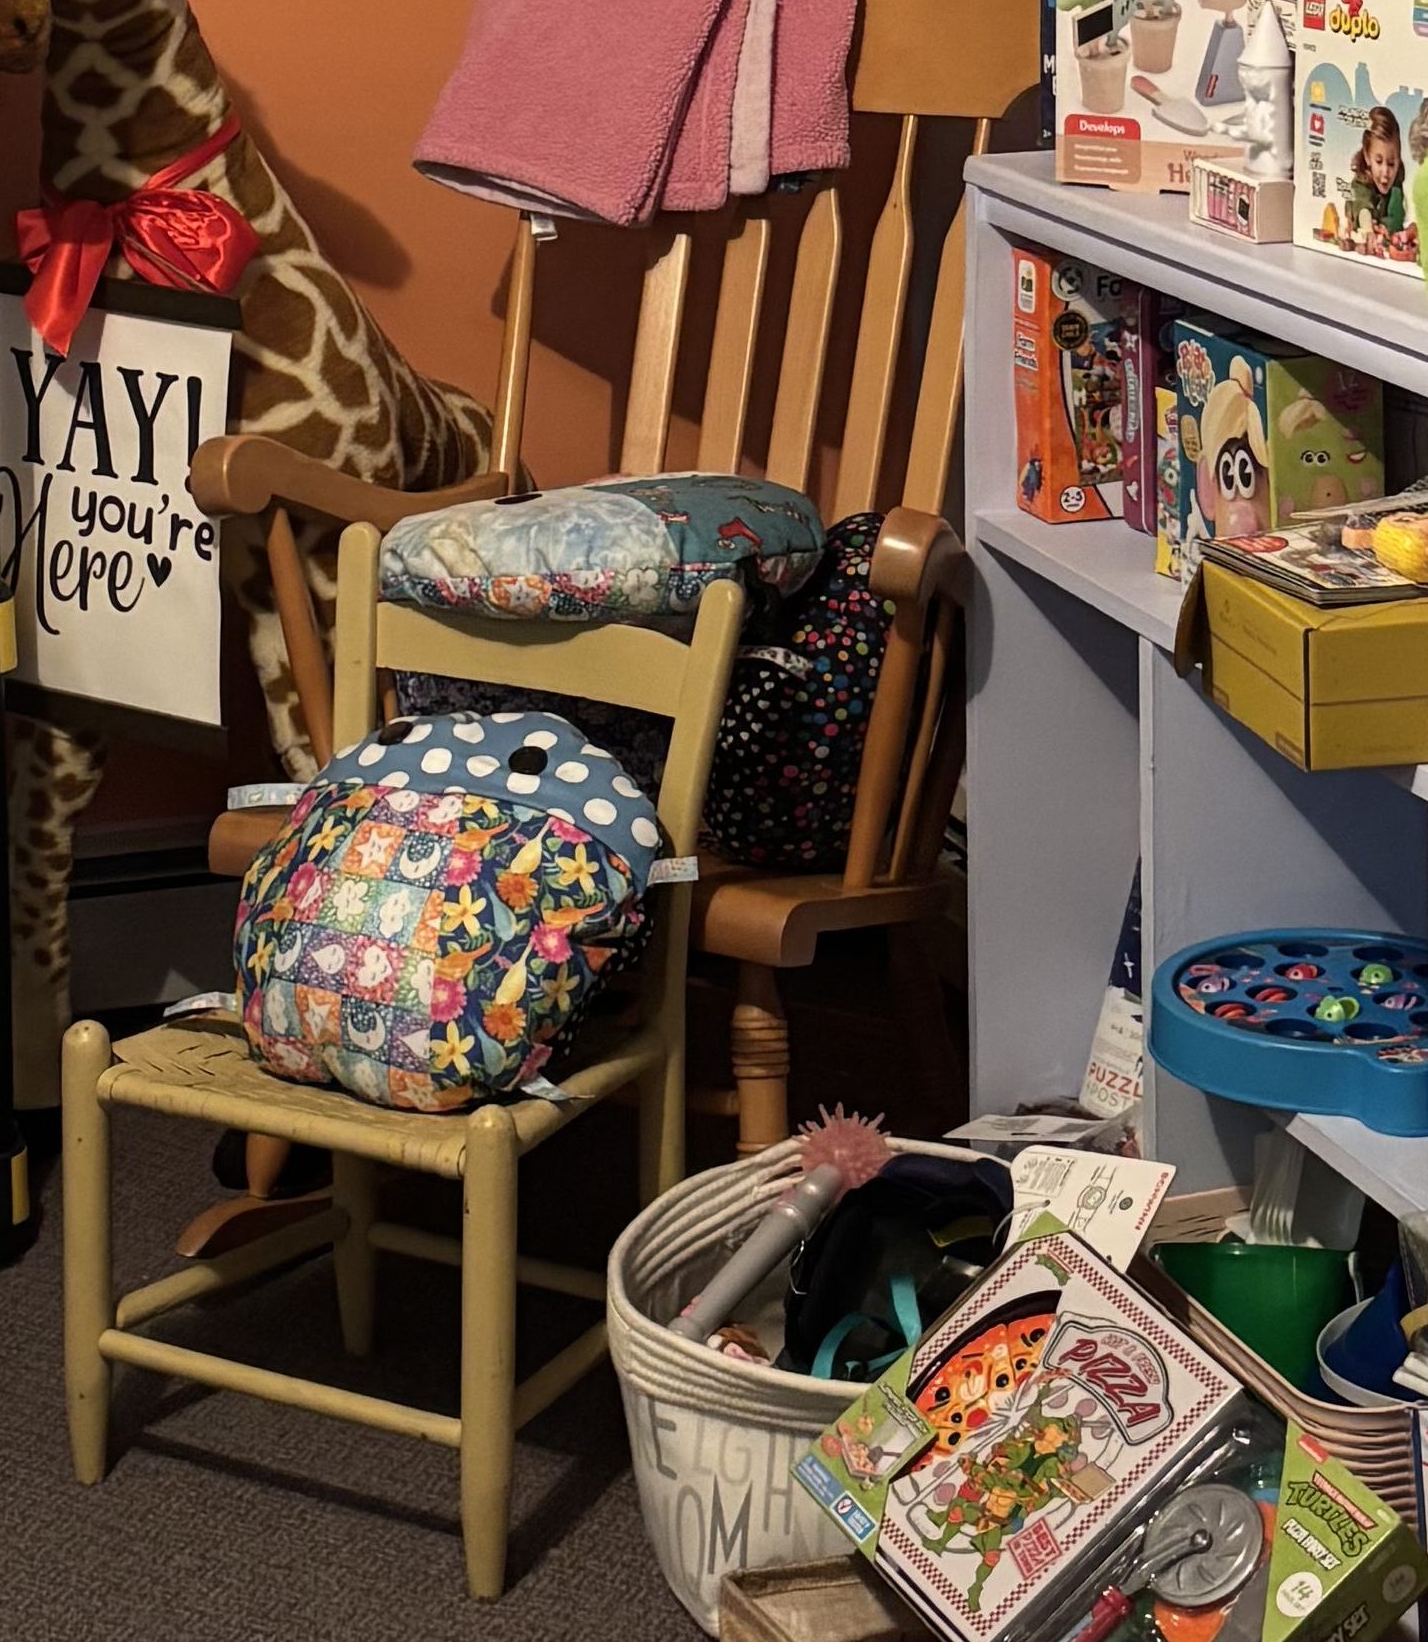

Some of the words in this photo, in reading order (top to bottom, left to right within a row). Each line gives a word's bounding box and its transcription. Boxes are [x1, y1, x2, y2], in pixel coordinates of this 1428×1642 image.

[1328, 5, 1381, 43] duplo
[10, 346, 202, 494] YAY!
[71, 485, 215, 561] you're
[1057, 1337, 1162, 1429] PIZZA
[1032, 1518, 1057, 1559] BEST
[1284, 1480, 1372, 1558] TURTLES
[1291, 1580, 1314, 1601] 14
